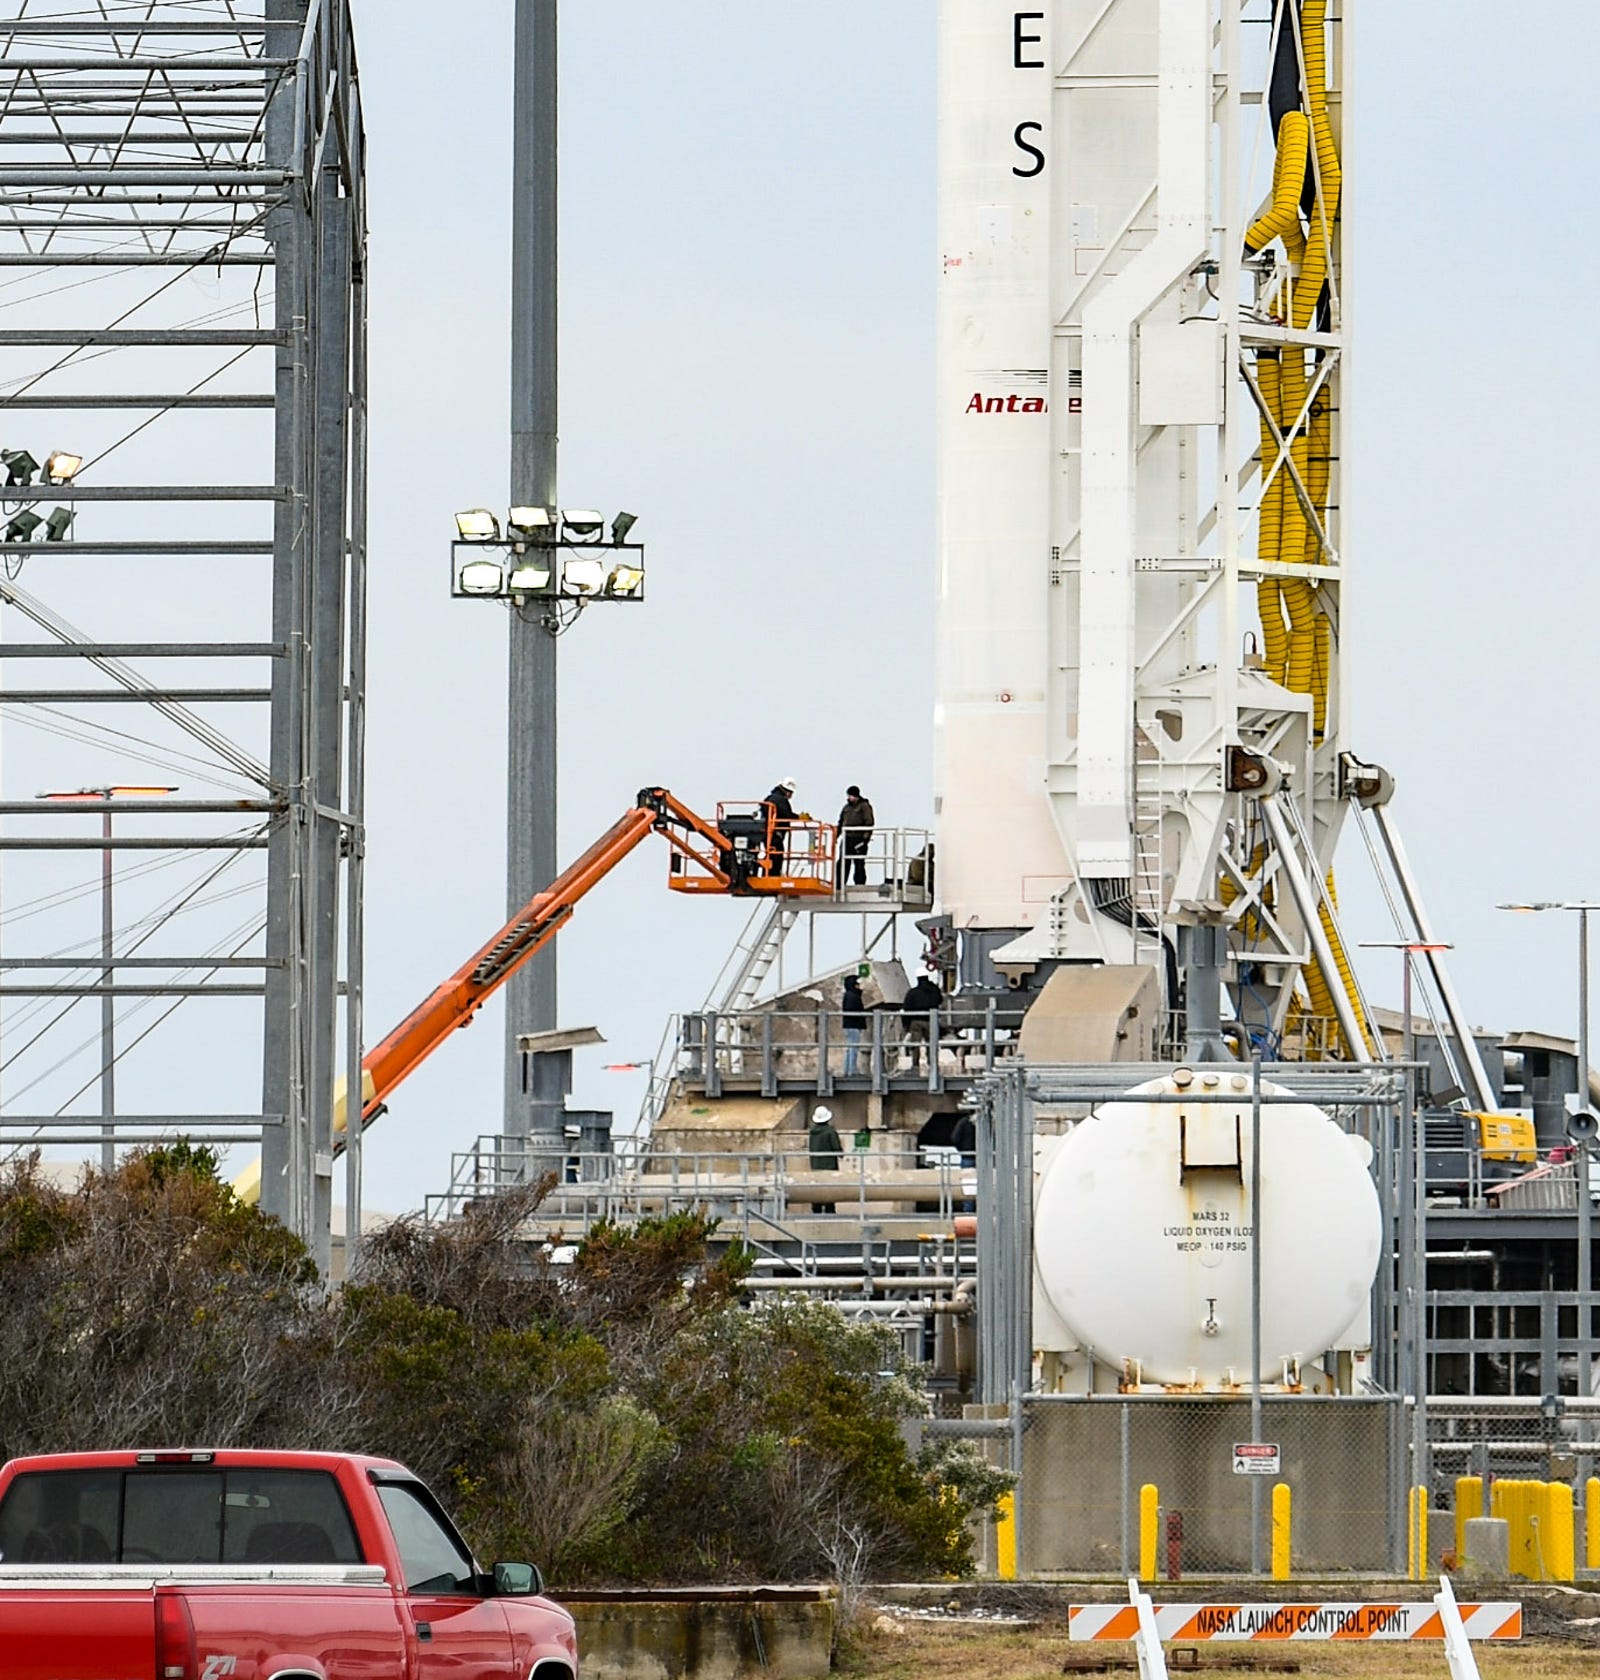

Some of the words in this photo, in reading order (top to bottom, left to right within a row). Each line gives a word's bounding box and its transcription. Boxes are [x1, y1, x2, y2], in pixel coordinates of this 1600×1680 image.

[1192, 1212, 1218, 1221] MARS
[1163, 1227, 1193, 1237] LIQUID
[1195, 1227, 1231, 1237] OXYGEN
[1177, 1242, 1202, 1252] MEOP
[1226, 1242, 1247, 1252] PSIG
[1197, 1610, 1235, 1633] NASA
[1239, 1610, 1293, 1633] LAUNCH
[1297, 1610, 1364, 1633] CONTROL
[1368, 1610, 1410, 1633] POINT
[202, 1655, 237, 1680] Z71
